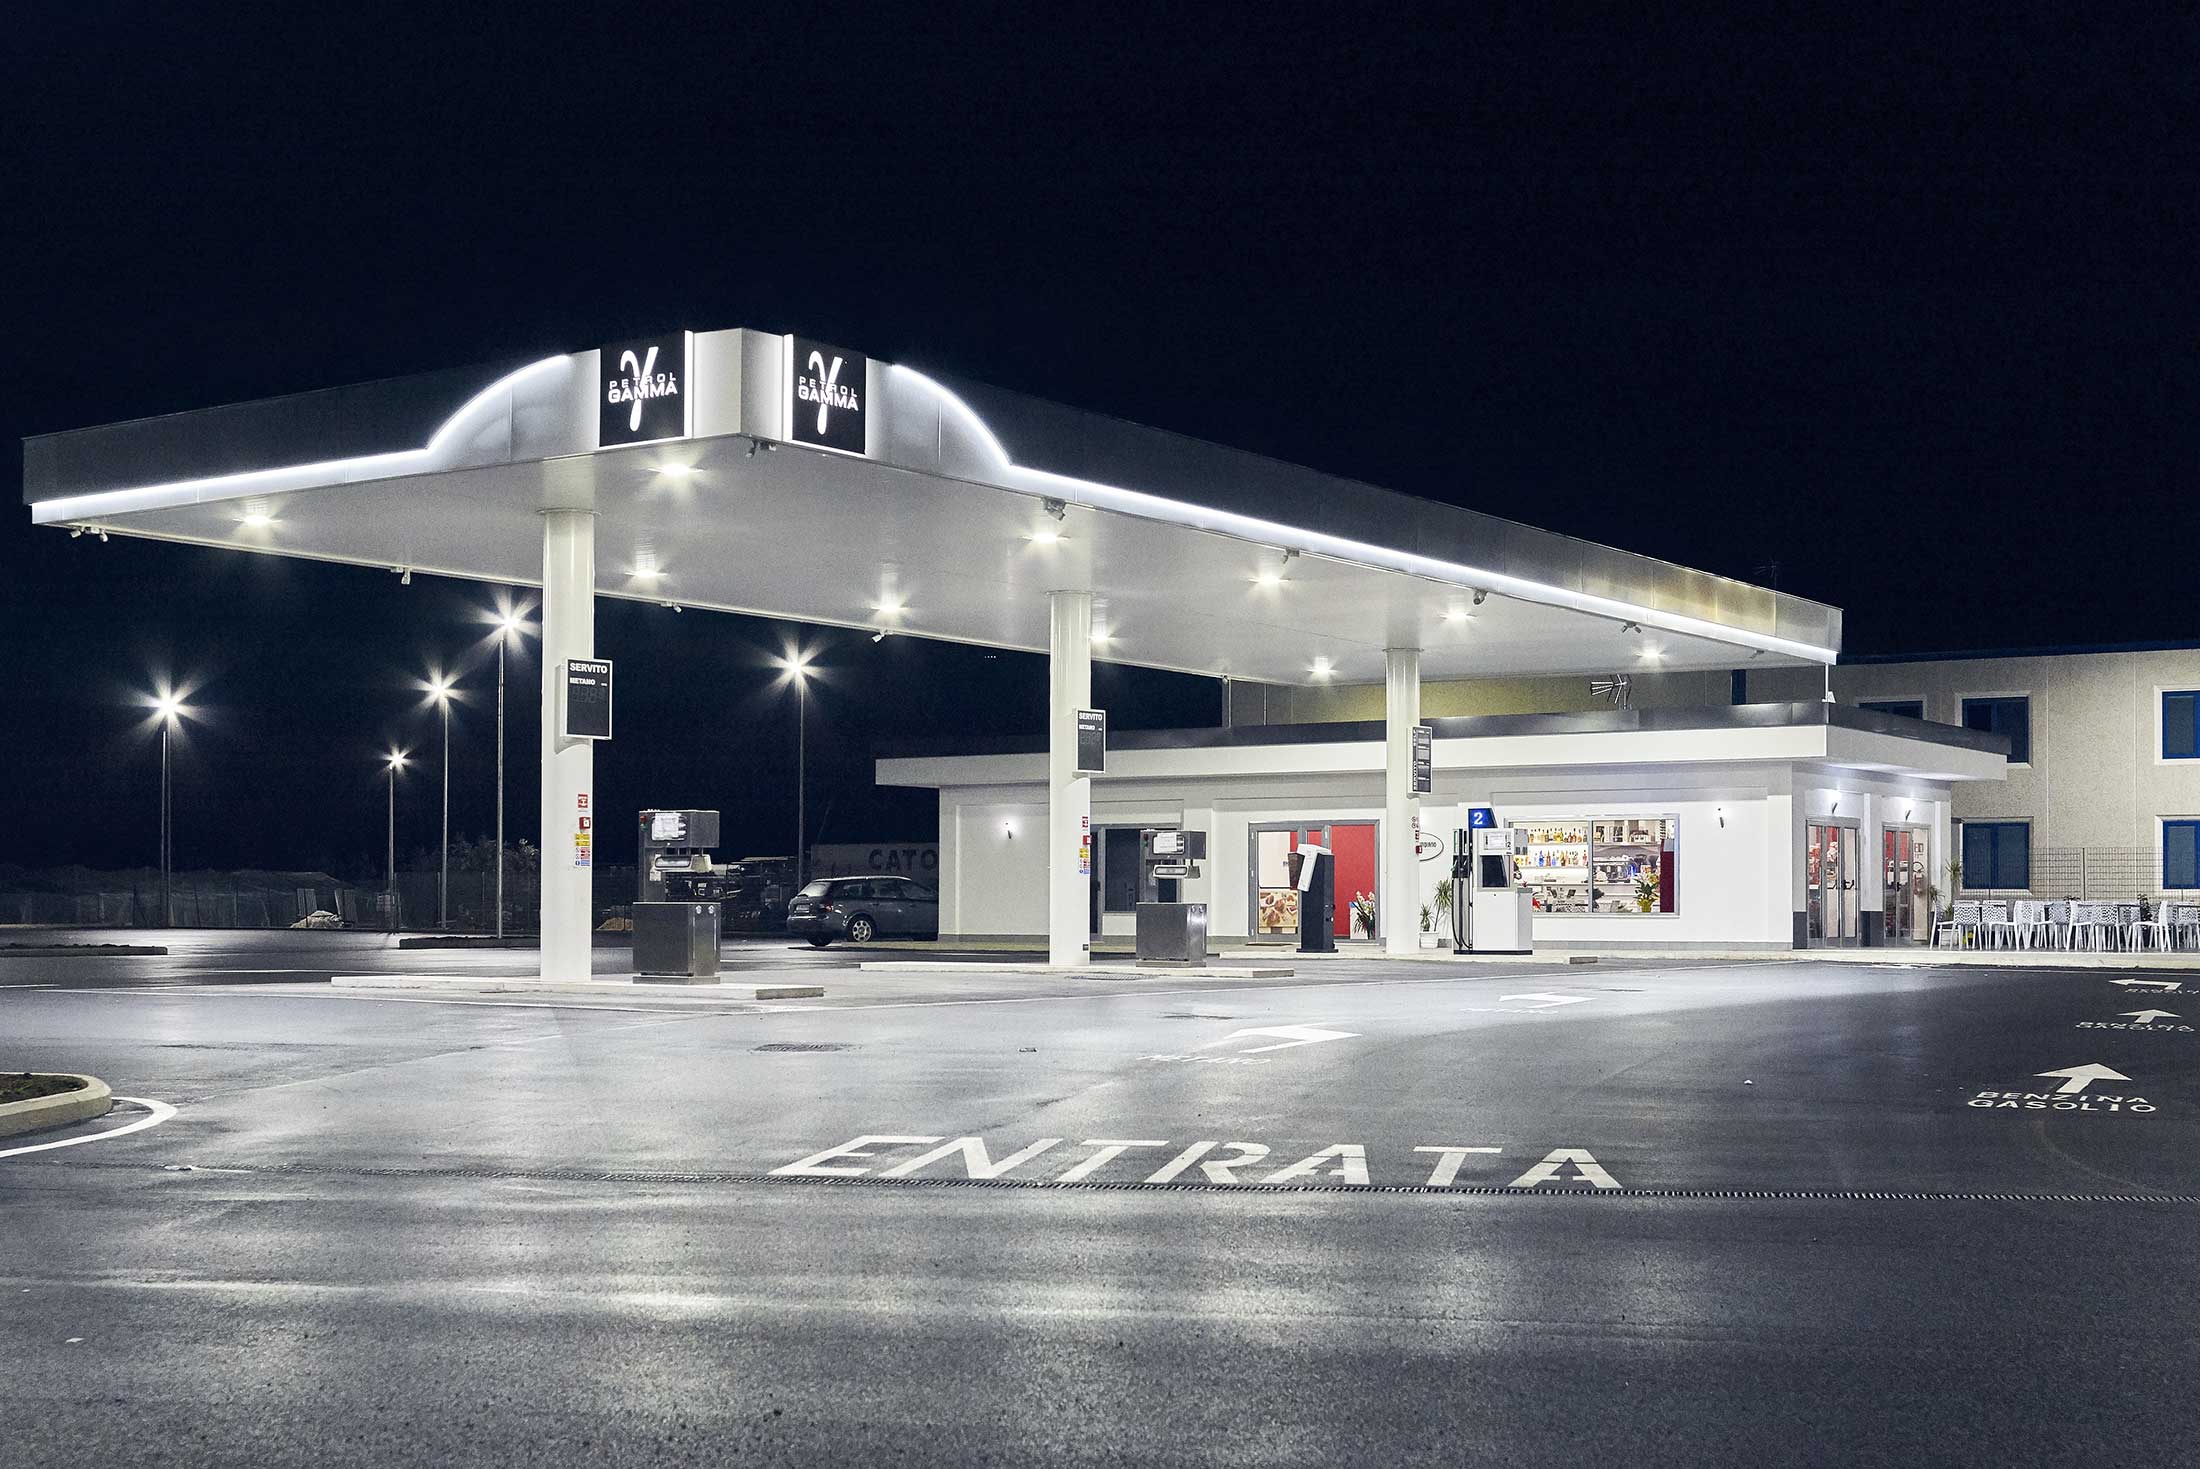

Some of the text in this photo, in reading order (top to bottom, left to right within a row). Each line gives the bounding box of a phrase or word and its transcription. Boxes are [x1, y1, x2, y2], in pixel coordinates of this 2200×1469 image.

[609, 372, 677, 390] PETROL
[799, 376, 858, 398] PETROL
[608, 381, 678, 404] GAMMA
[798, 385, 859, 411] GAMMA
[570, 662, 608, 674] SERVITO
[1079, 712, 1103, 721] SERVITO
[1473, 811, 1483, 825] 2
[1976, 1091, 2149, 1103] BENZINA
[1967, 1099, 2157, 1112] GASOLIO
[766, 1135, 1624, 1189] ENTRATA
